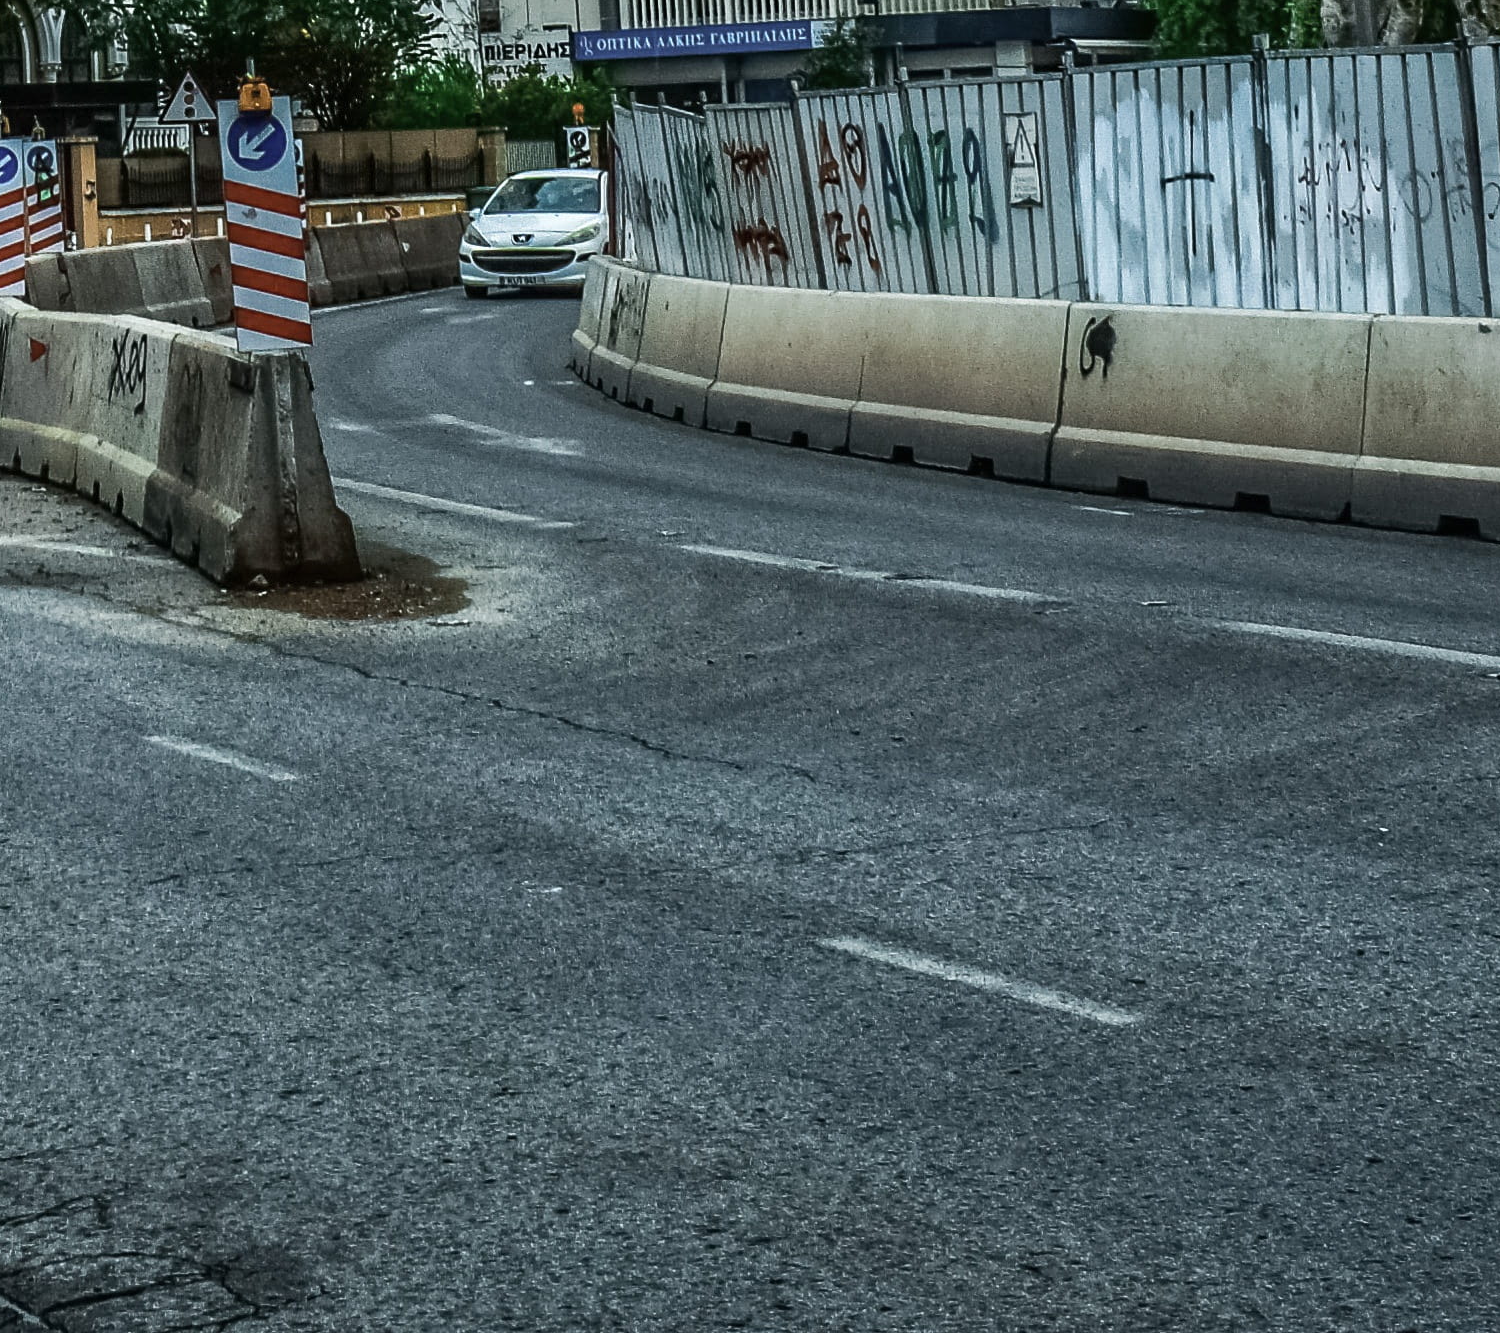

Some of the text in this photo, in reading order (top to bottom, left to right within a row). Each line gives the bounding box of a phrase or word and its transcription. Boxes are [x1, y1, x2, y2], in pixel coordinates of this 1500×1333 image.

[484, 41, 571, 61] ΠΙΕΡΙΔΗΣ
[596, 36, 652, 52] ΟΠΤΙΚΑ
[656, 32, 705, 49] ΛΑΚΗΣ
